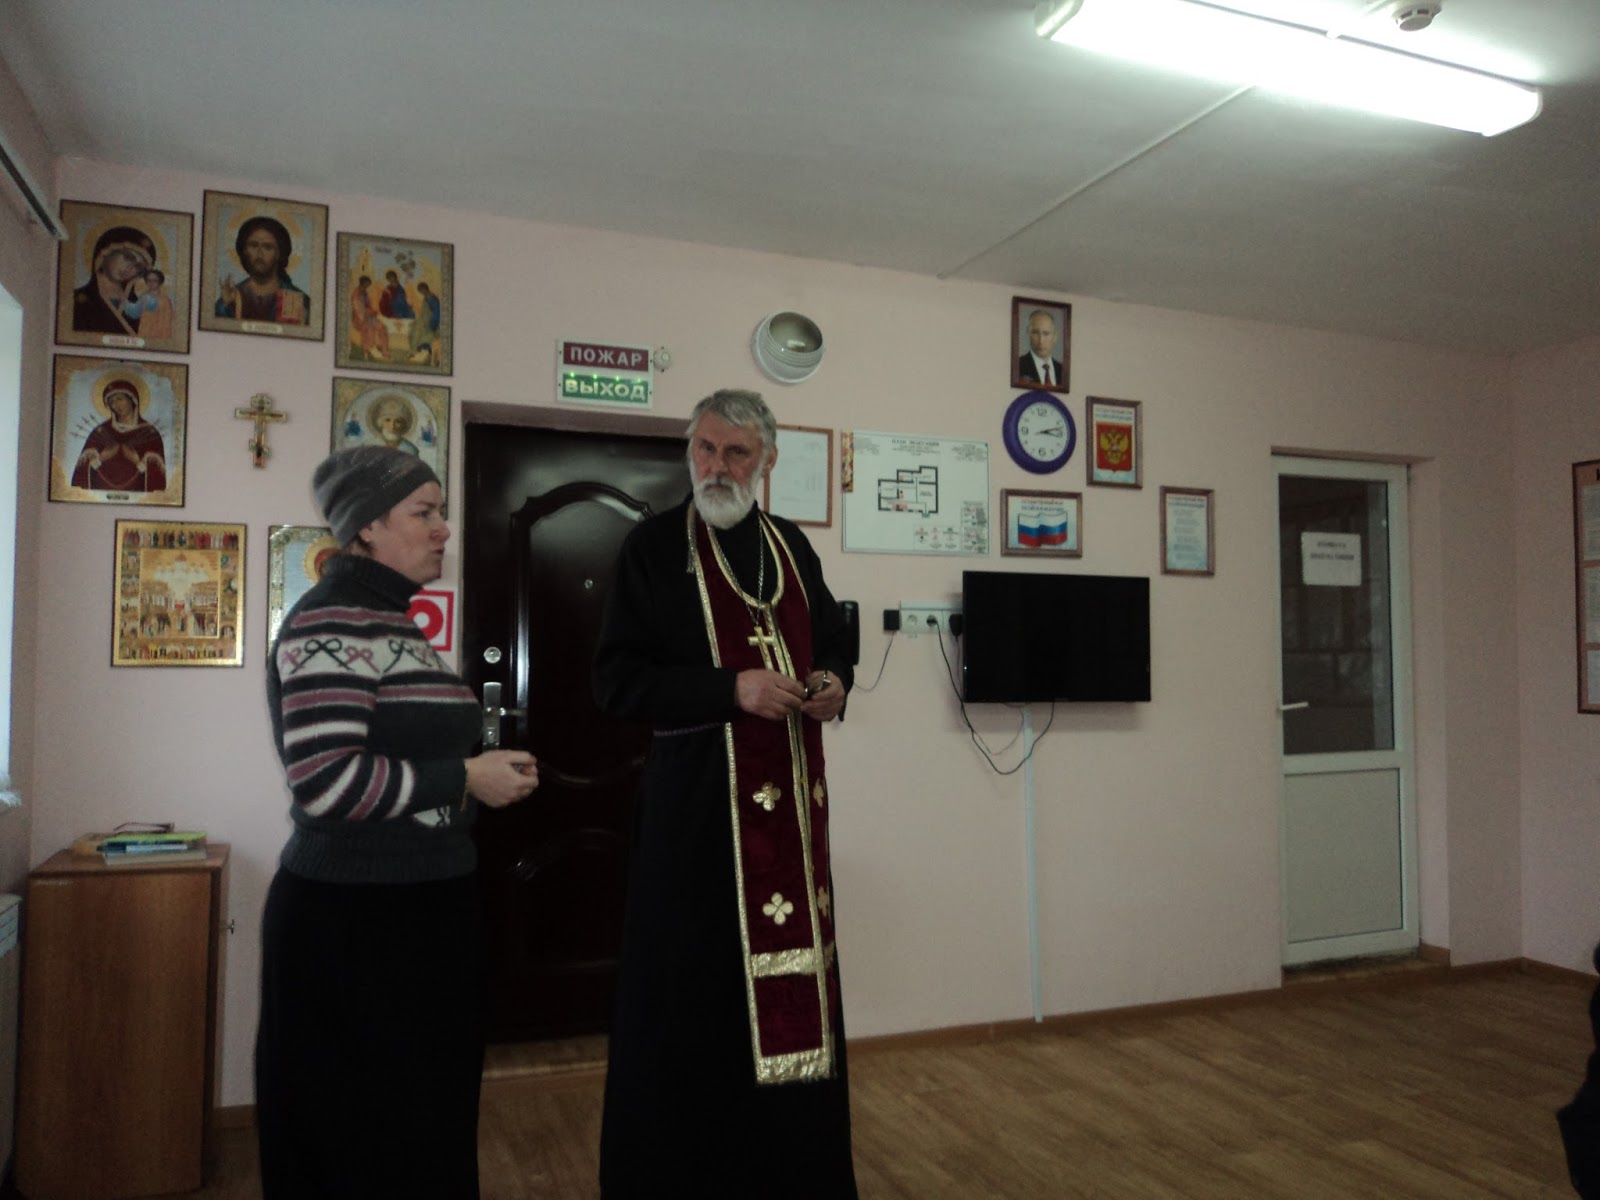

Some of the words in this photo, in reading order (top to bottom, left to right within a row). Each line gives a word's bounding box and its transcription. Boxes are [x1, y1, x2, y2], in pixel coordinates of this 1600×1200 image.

[570, 346, 642, 367] ПОЖАР
[565, 379, 646, 400] ВЫХОД
[1037, 407, 1048, 417] 12
[1039, 447, 1047, 456] 6
